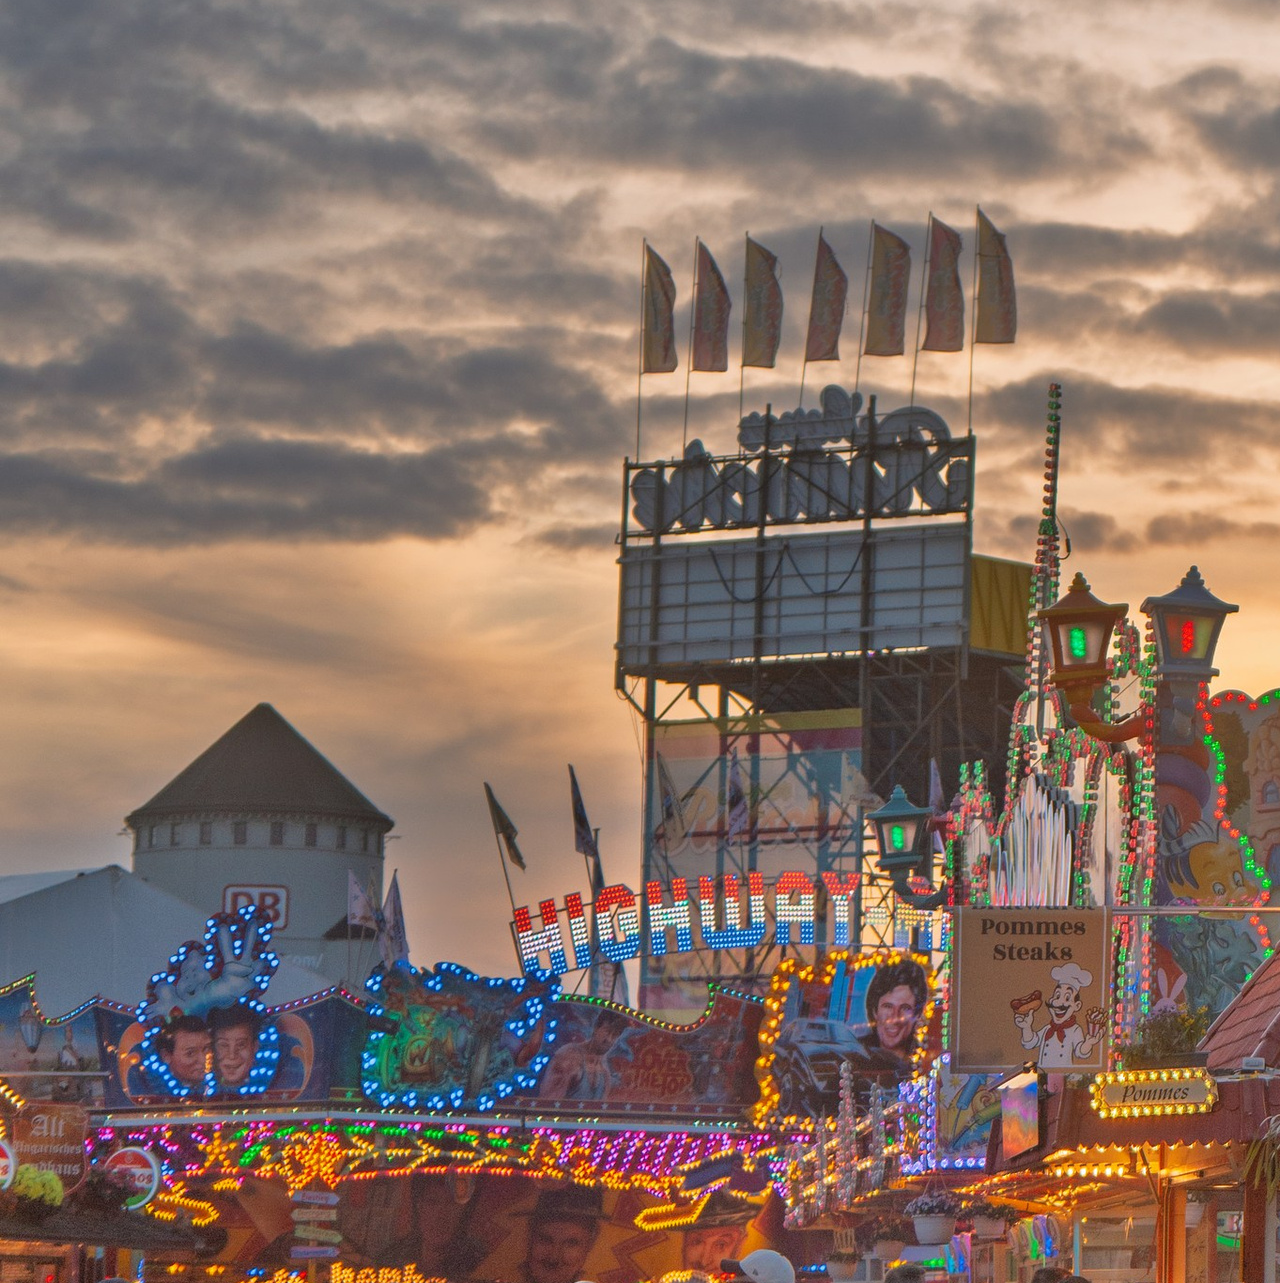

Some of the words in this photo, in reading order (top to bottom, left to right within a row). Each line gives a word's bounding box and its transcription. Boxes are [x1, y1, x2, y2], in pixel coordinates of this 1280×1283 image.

[981, 919, 1086, 935] Pommes
[993, 942, 1073, 961] Steaks
[1122, 1085, 1189, 1103] Pommes
[31, 1115, 65, 1138] Alt
